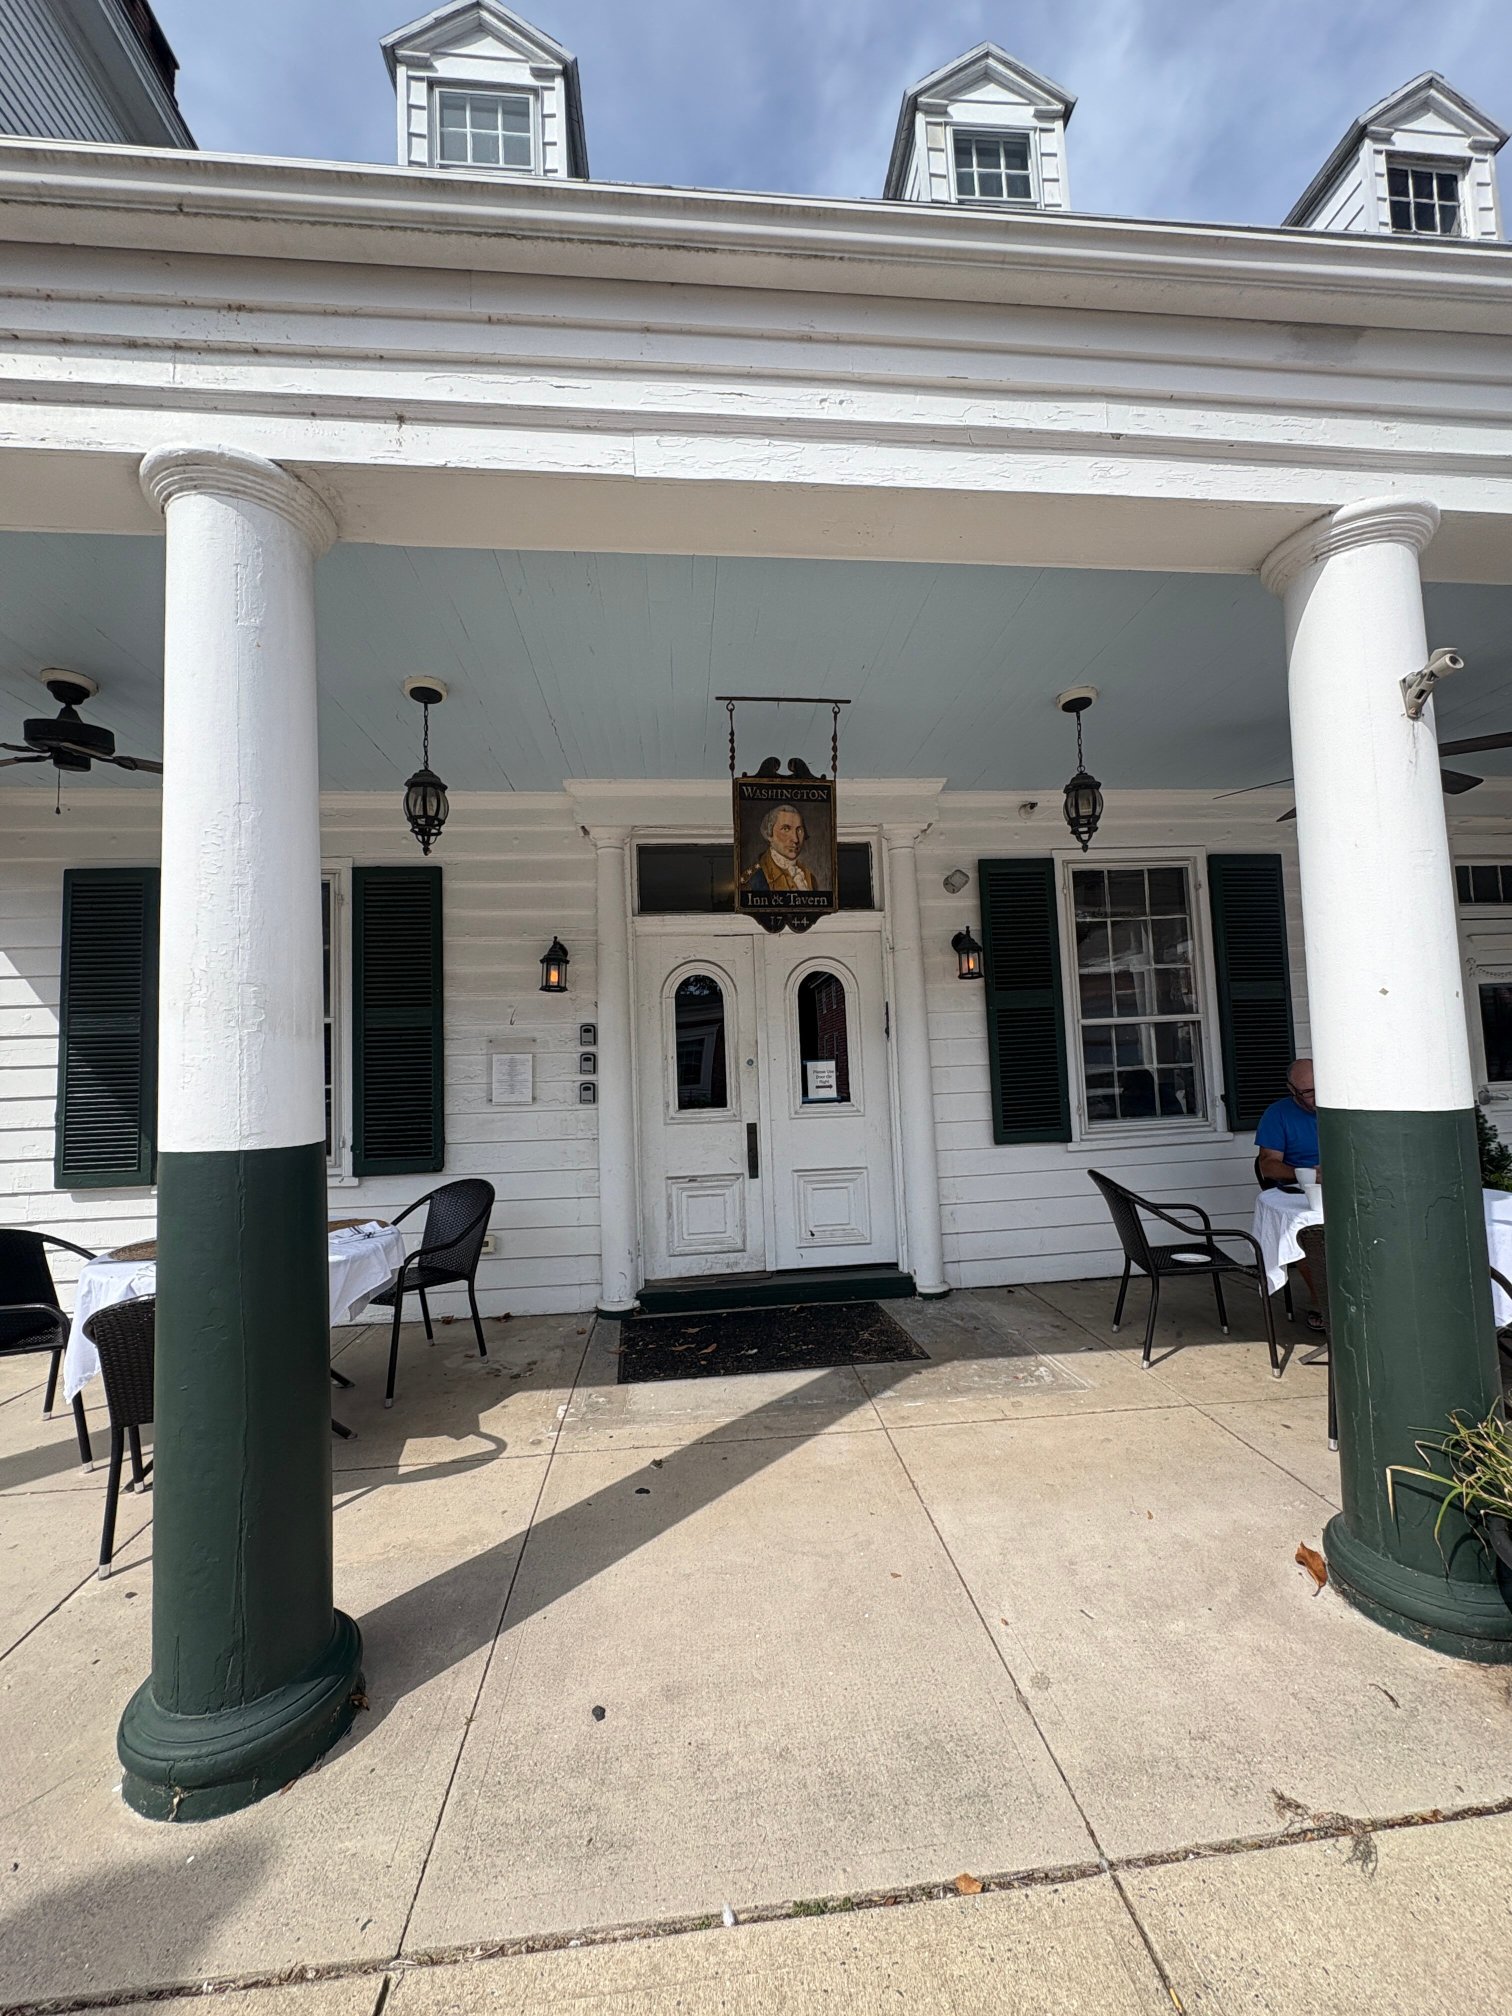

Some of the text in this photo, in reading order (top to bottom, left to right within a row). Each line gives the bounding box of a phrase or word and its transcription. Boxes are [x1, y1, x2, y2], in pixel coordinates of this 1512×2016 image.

[742, 786, 828, 800] WASHINGTON
[748, 893, 828, 906] Inn & Tavern
